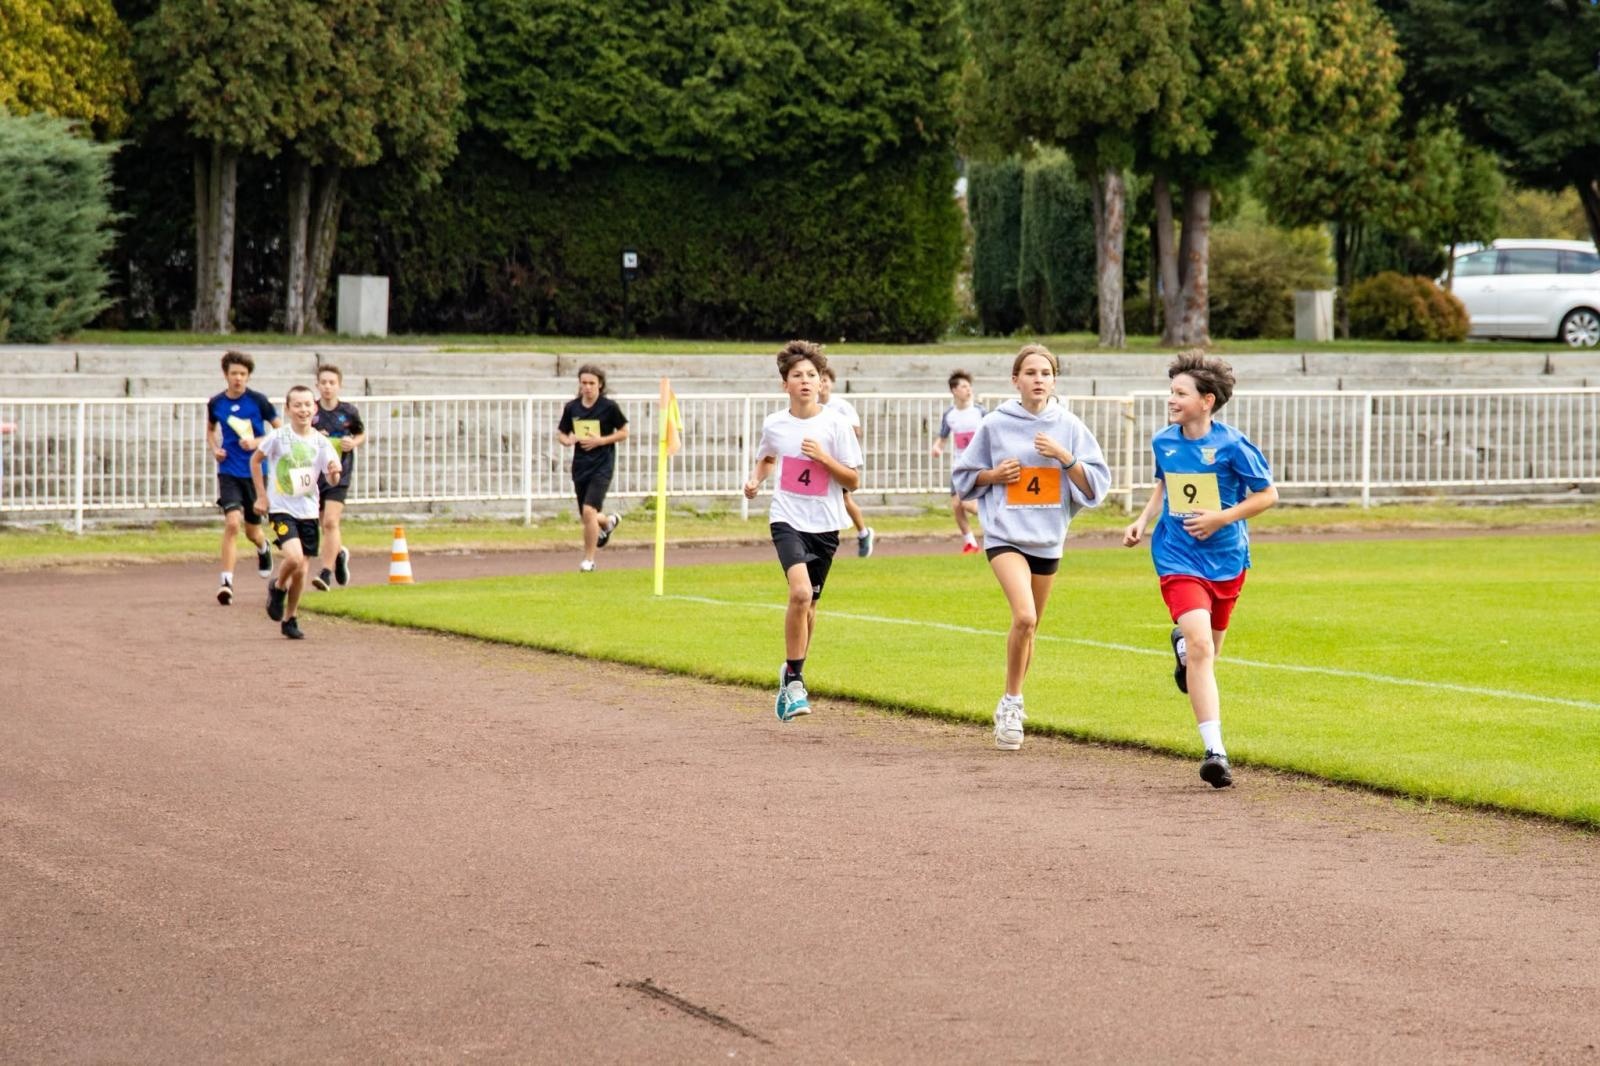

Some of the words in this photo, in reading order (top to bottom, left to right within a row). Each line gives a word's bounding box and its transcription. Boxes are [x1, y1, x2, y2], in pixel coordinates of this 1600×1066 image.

[300, 474, 310, 487] 10
[797, 469, 811, 486] 4
[1027, 476, 1041, 495] 4
